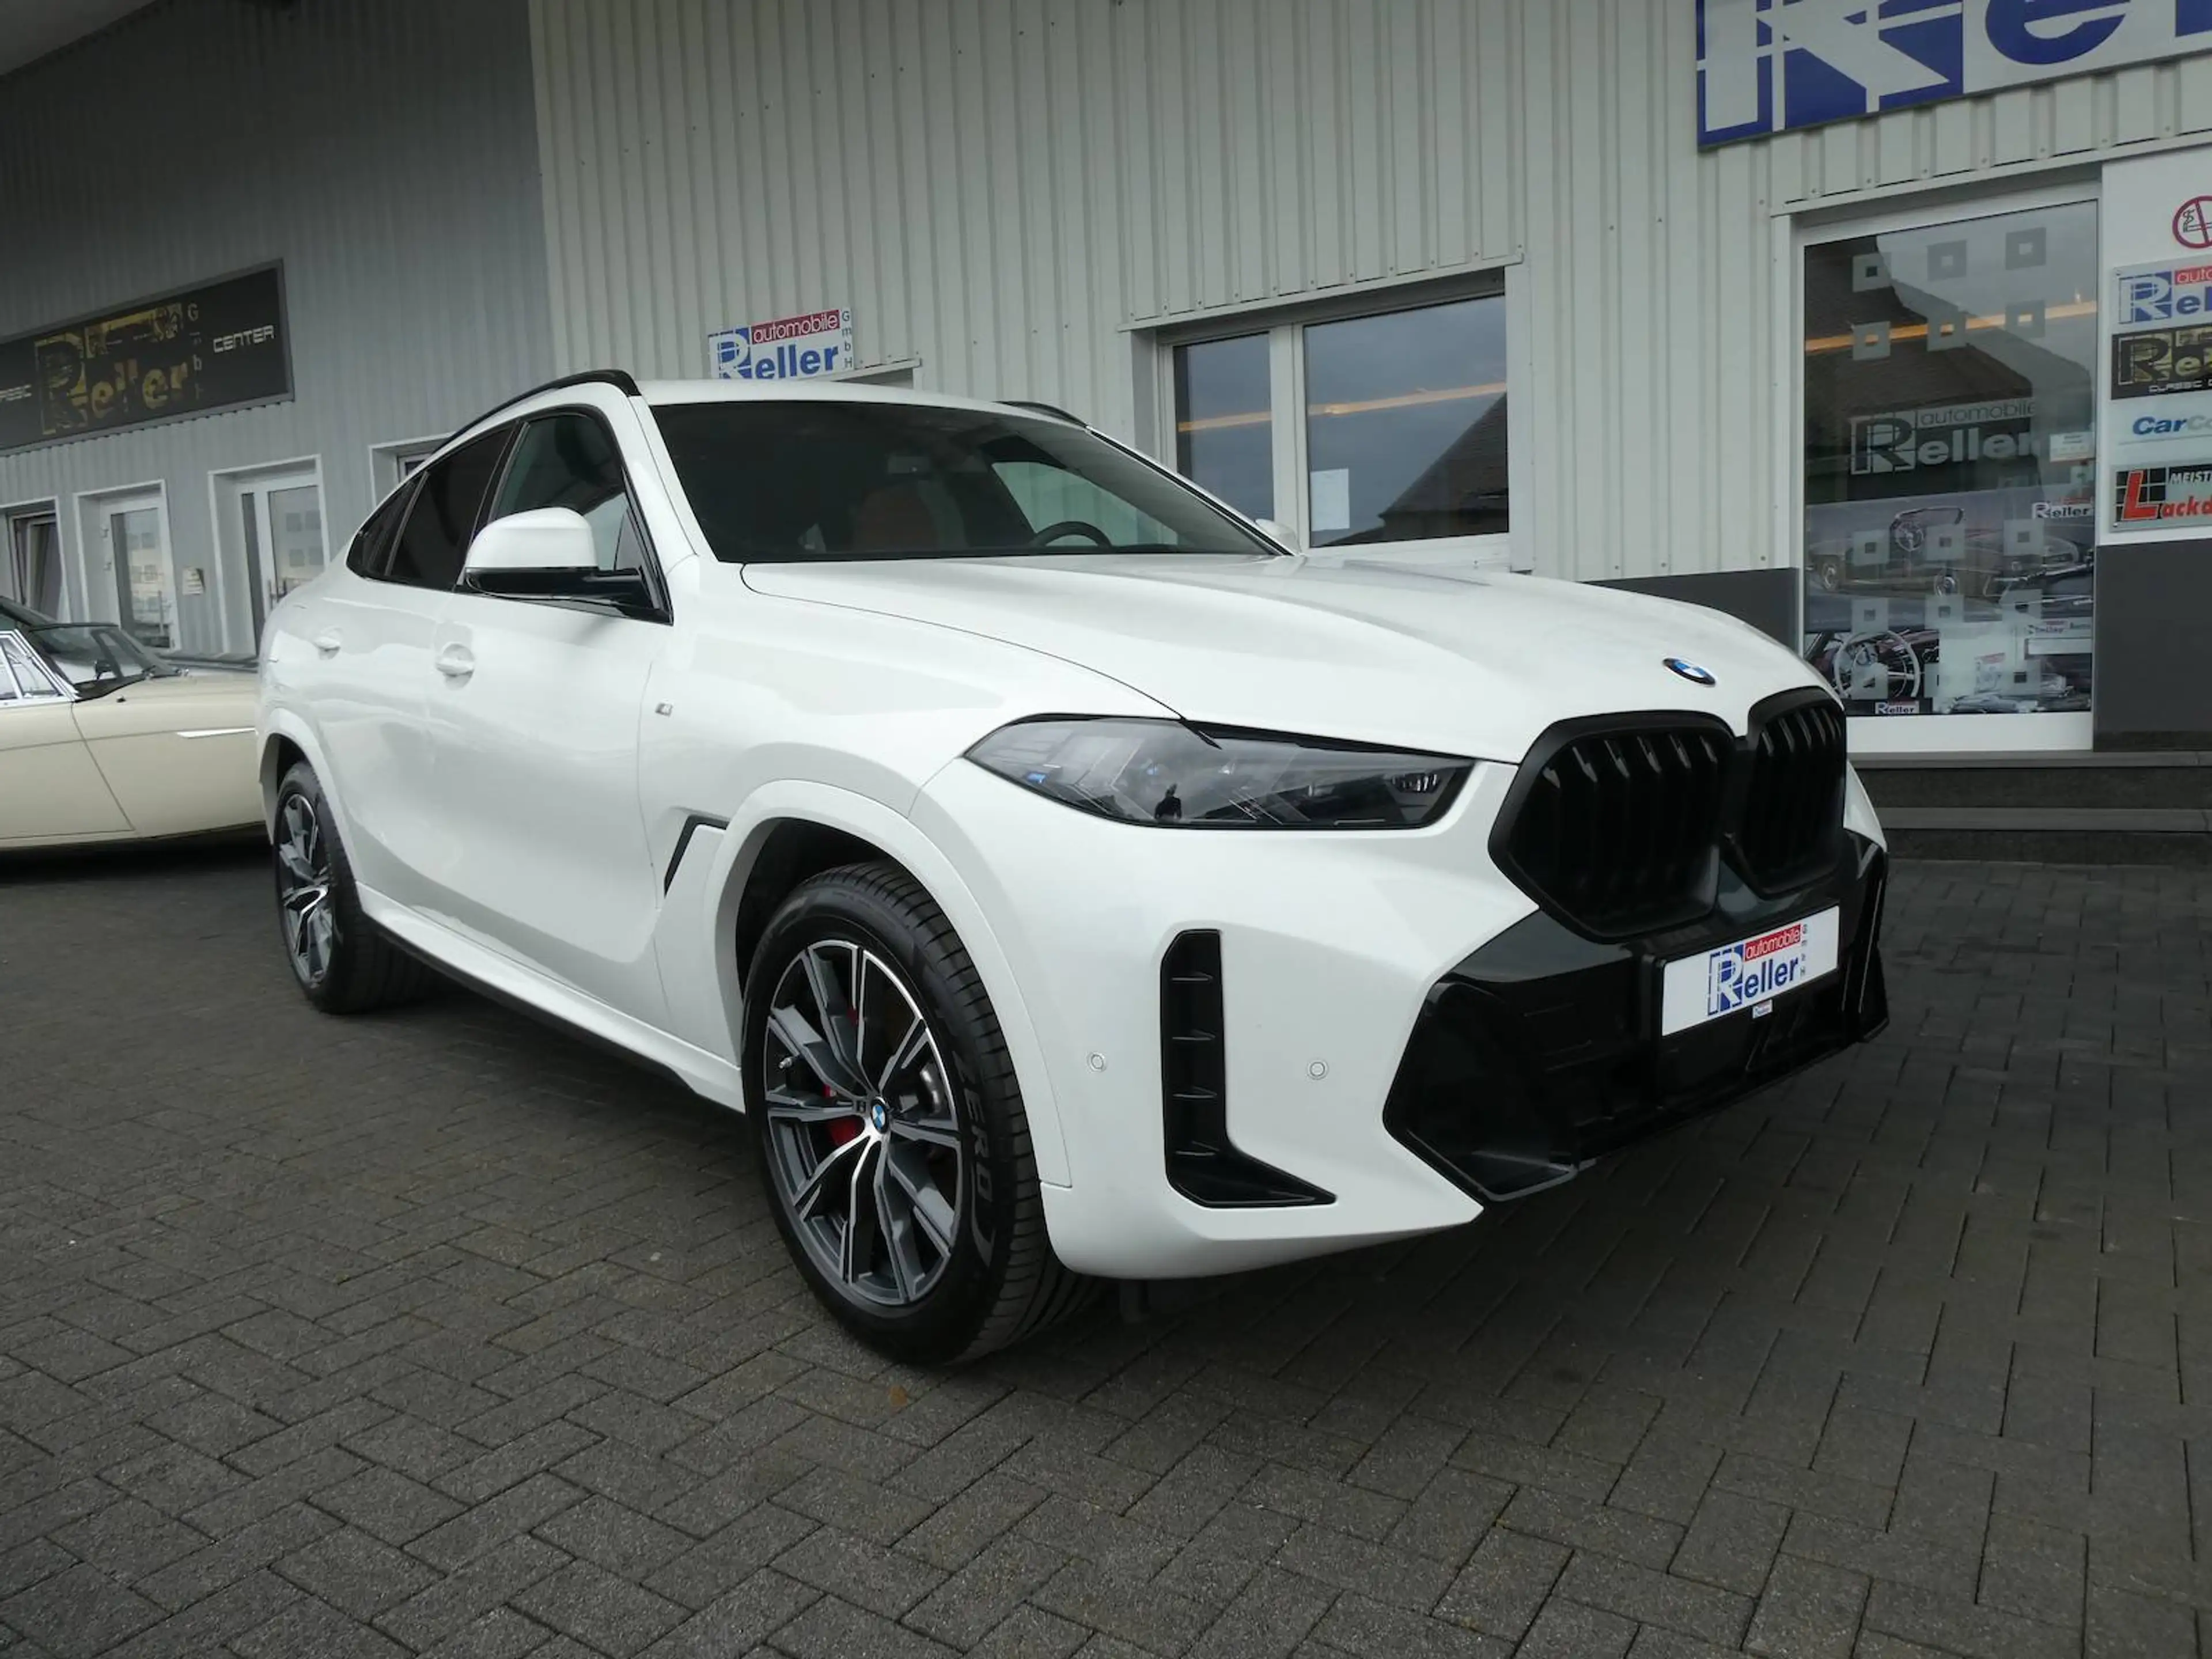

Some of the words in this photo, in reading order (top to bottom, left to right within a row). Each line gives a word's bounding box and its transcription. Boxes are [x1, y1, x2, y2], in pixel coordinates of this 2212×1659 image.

[213, 324, 276, 354] CENTER
[753, 313, 839, 343] automobile
[708, 327, 839, 380] Reller
[1921, 399, 2036, 426] automobile
[1850, 411, 2040, 475] Reller
[1745, 927, 1801, 960] automobile
[1707, 944, 1798, 1016] Reller
